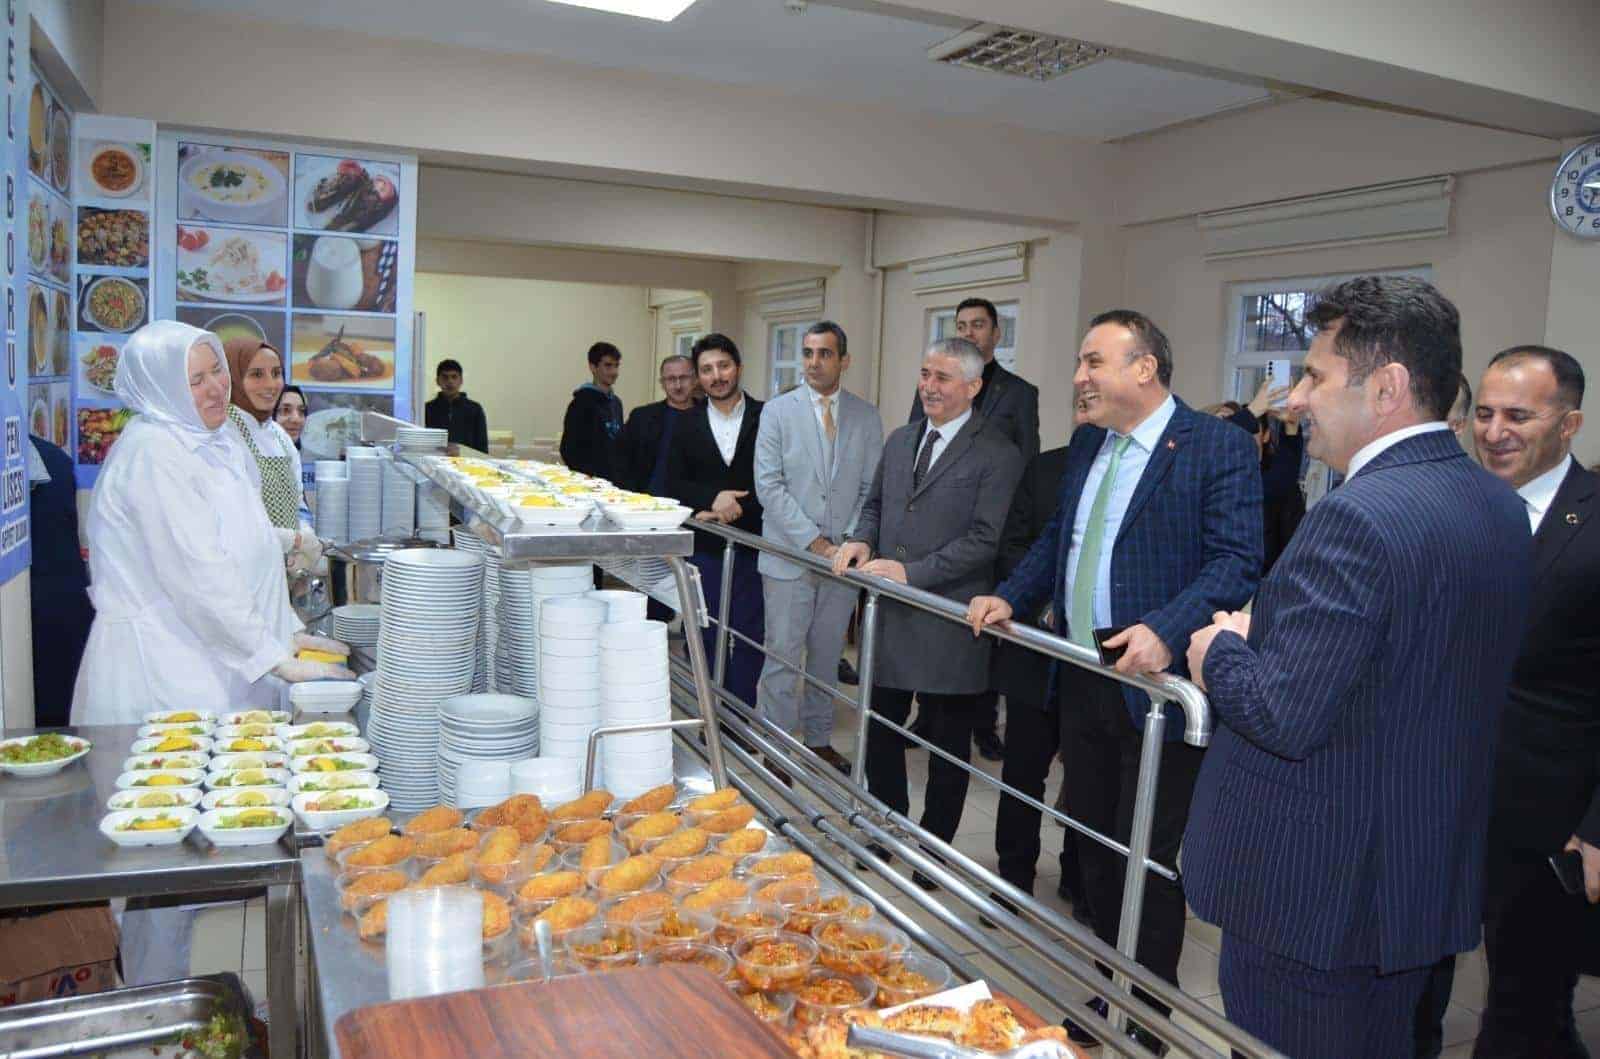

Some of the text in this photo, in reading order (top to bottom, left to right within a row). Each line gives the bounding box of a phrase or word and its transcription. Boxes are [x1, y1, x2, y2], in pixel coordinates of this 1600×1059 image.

[1567, 170, 1579, 180] 10
[1561, 187, 1569, 198] 9
[1566, 206, 1574, 216] 8
[1576, 216, 1585, 230] 7
